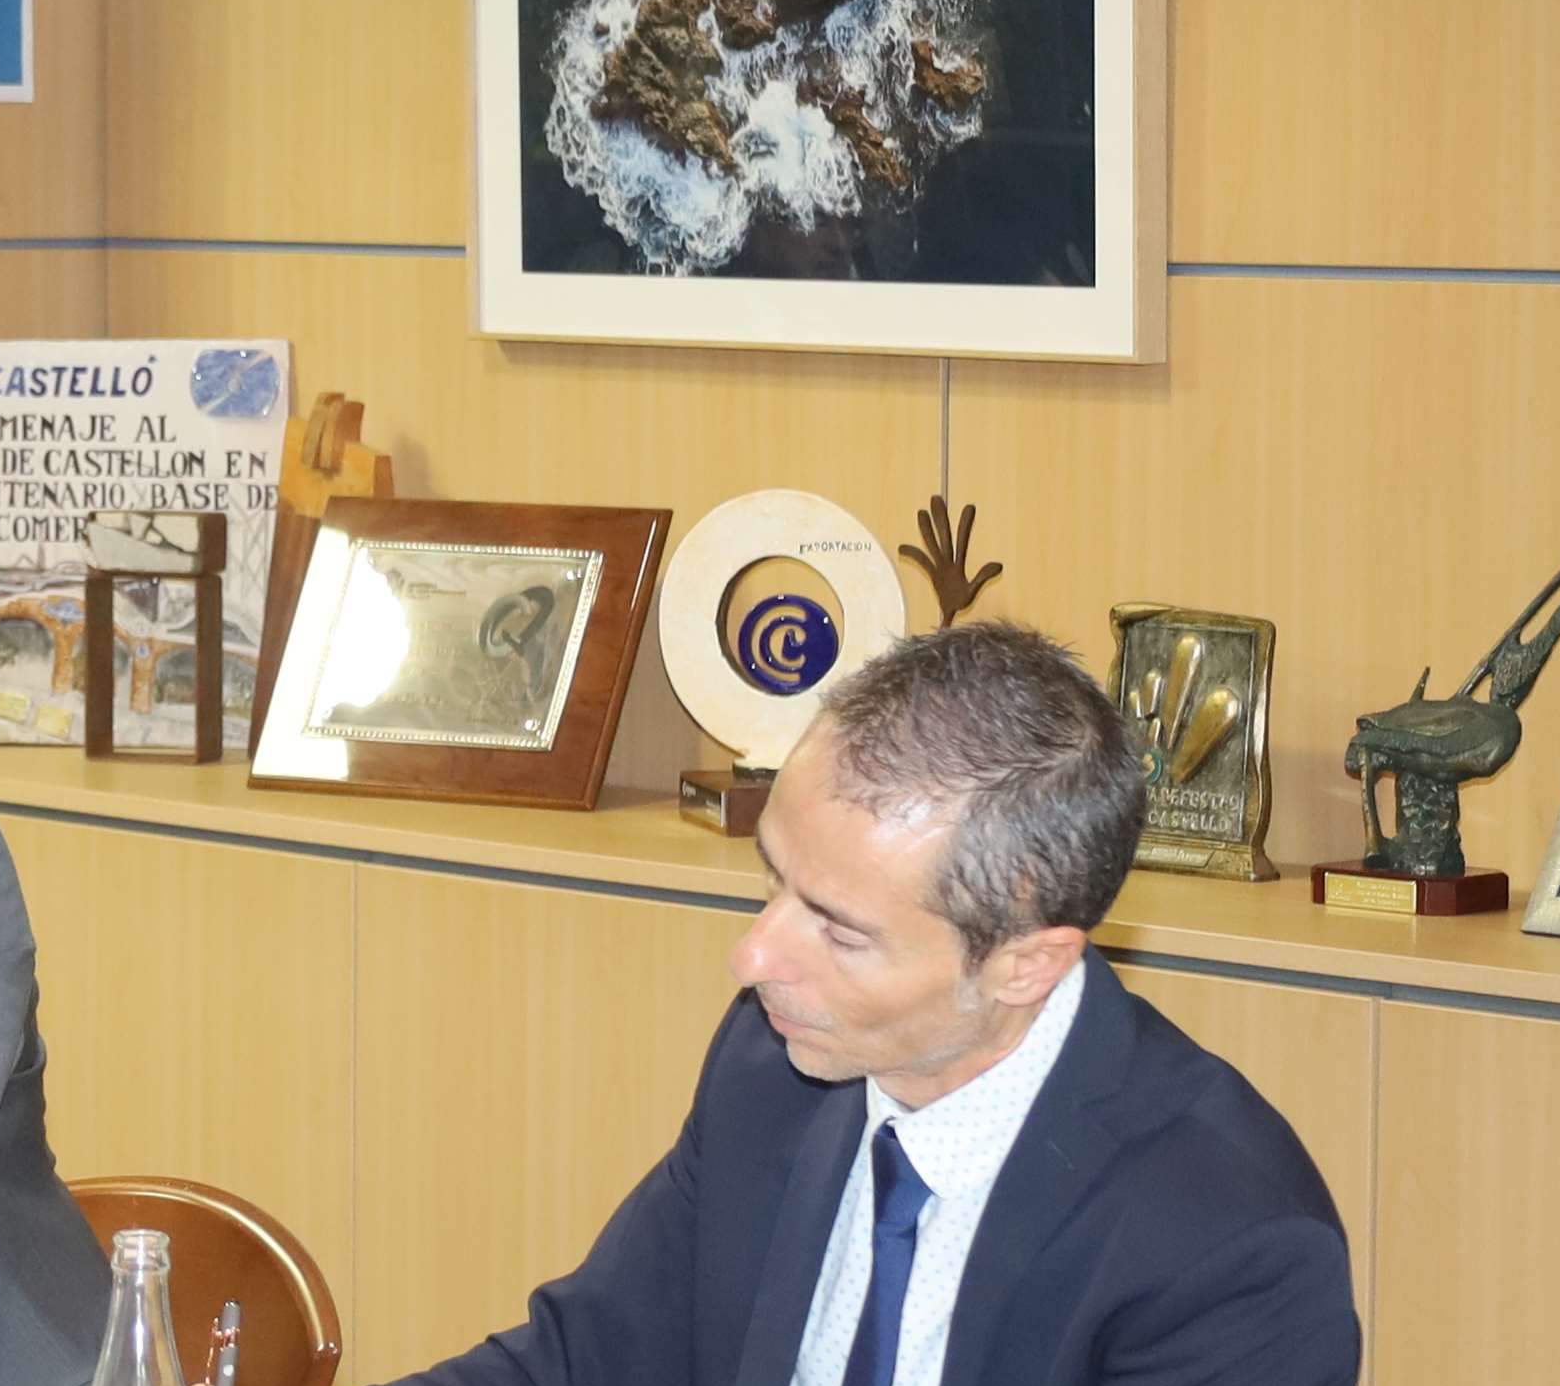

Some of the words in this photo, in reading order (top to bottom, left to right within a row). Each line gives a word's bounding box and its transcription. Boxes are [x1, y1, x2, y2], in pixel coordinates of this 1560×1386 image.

[134, 415, 176, 443] AL
[1, 449, 32, 476] DE
[225, 450, 268, 477] EN
[150, 481, 229, 510] BASE
[248, 483, 279, 510] DE
